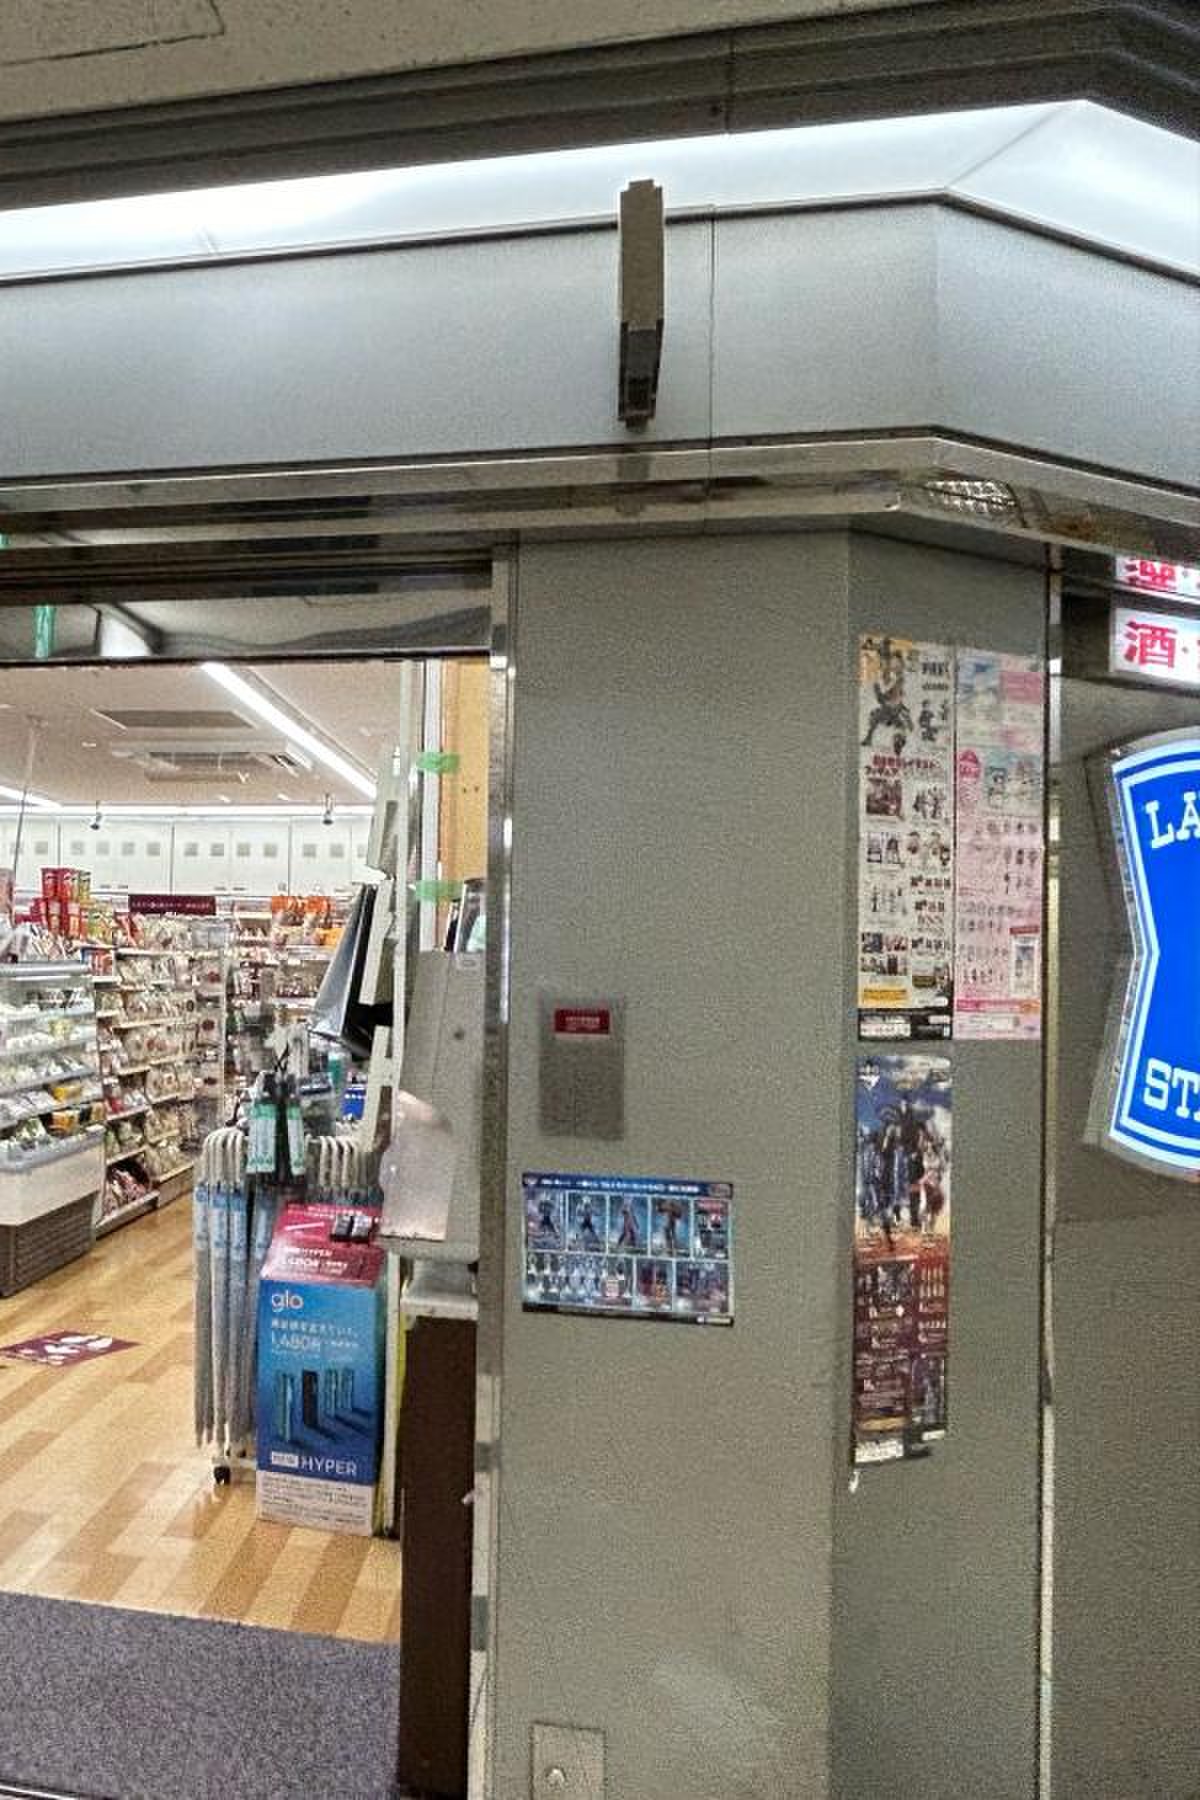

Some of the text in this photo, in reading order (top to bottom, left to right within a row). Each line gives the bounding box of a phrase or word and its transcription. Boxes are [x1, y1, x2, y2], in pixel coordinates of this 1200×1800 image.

[1145, 791, 1200, 848] LA
[1143, 1057, 1200, 1122] ST
[271, 1289, 304, 1313] glo
[302, 1456, 357, 1476] HYPER
